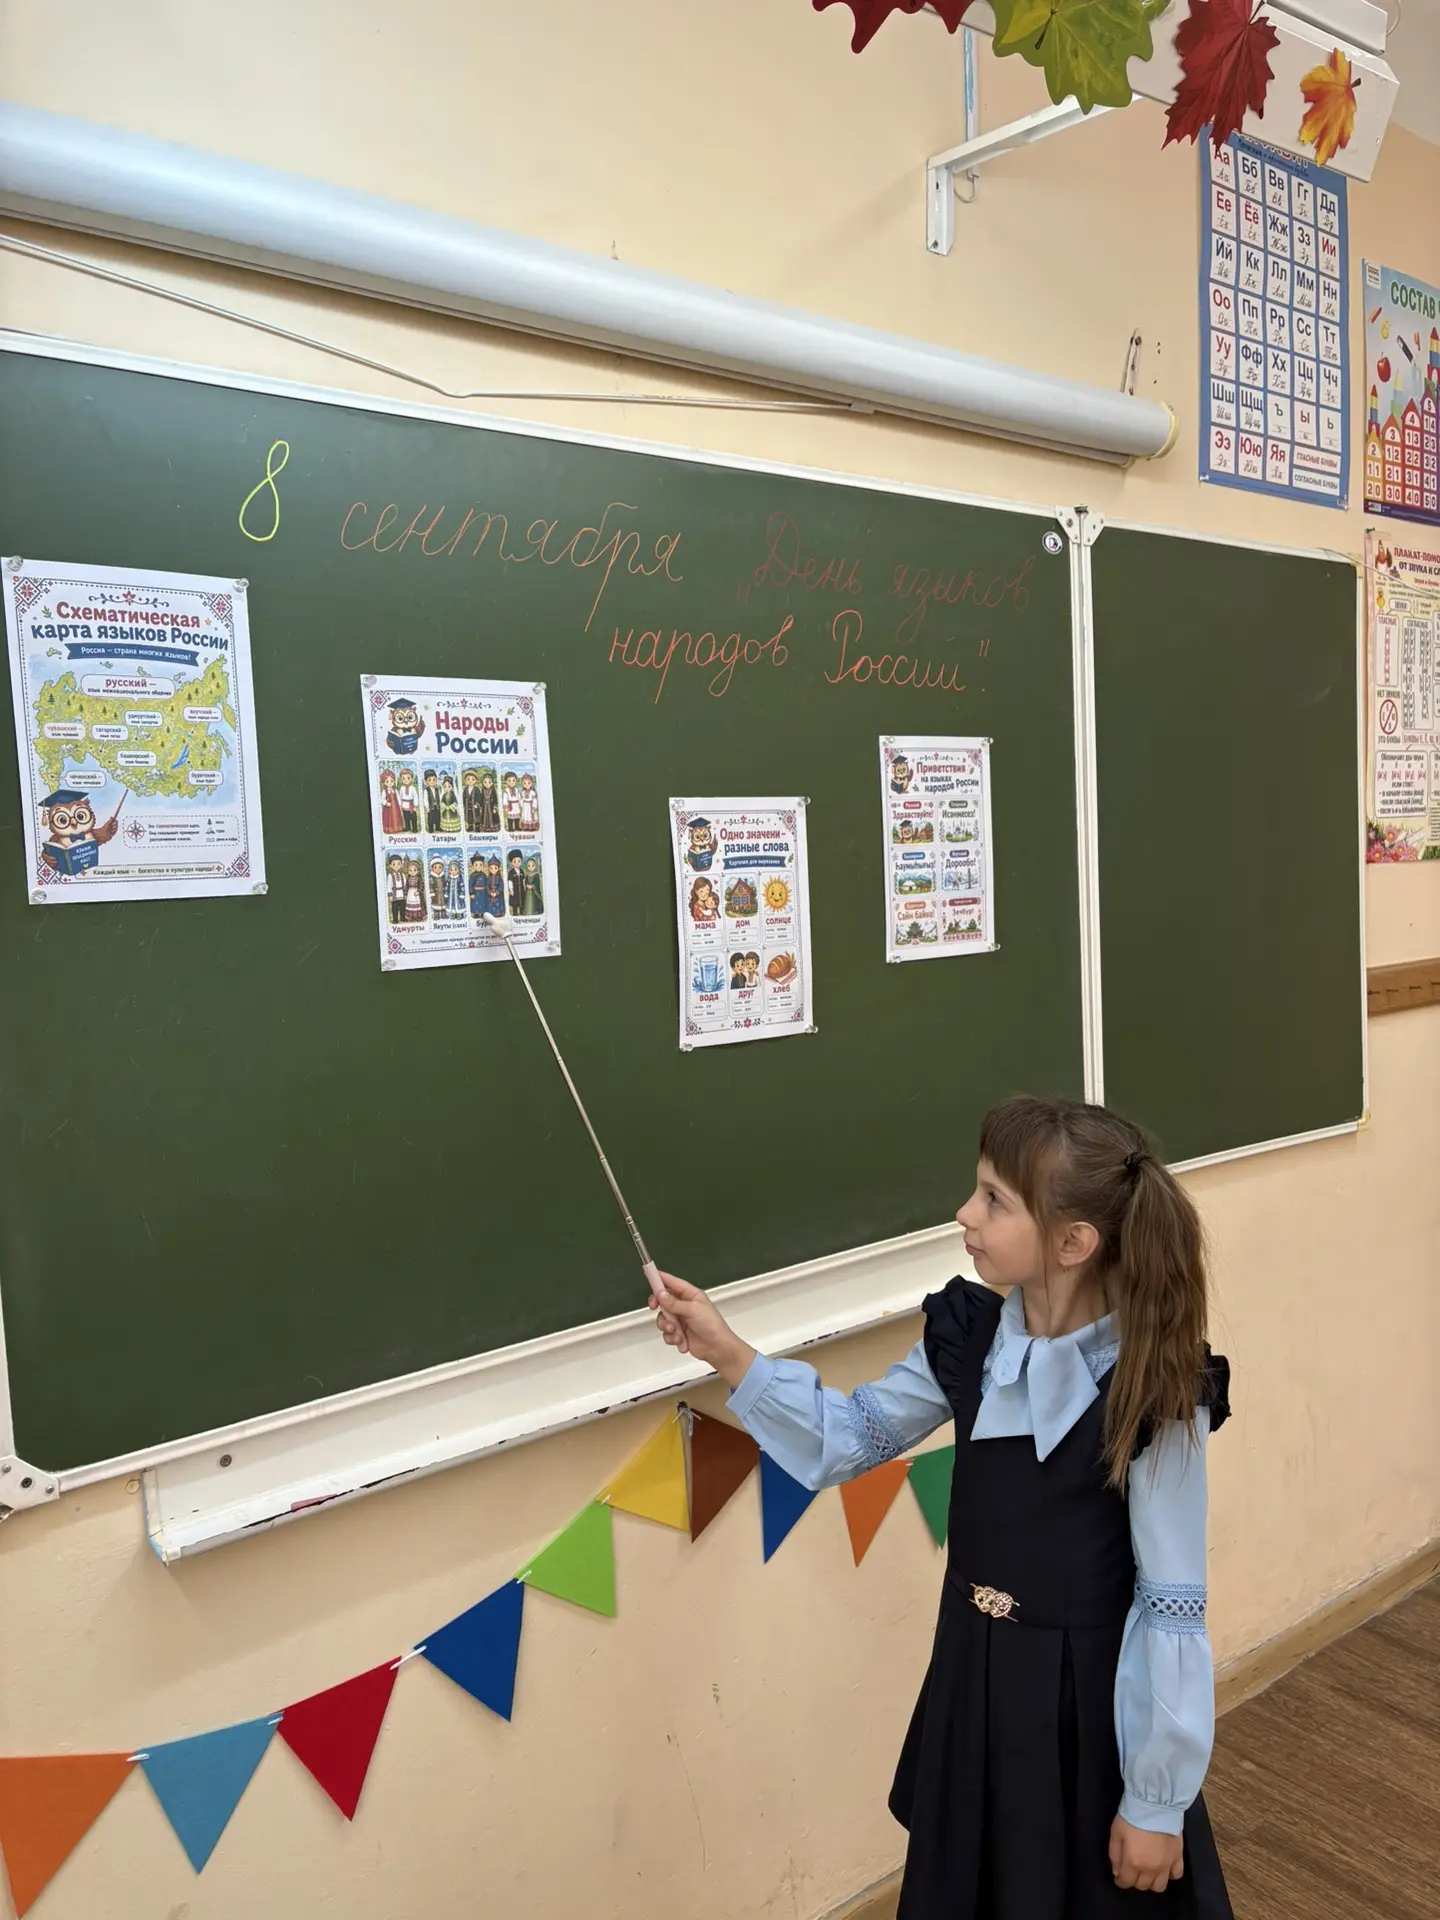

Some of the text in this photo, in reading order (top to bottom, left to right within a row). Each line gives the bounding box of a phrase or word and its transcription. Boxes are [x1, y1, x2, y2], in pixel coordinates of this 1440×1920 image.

[1242, 157, 1258, 178] Бб
[1268, 169, 1284, 190] Вв
[1297, 182, 1308, 200] Гг
[1320, 194, 1336, 216] Дд
[1216, 190, 1336, 257] Ее Ёё Жж Зз Ии
[1216, 237, 1337, 300] Йй Кк Лл Мм Нн
[1391, 281, 1436, 319] СОСТАВ
[1213, 289, 1336, 344] Оо Пп Рр Сс Тт
[1216, 335, 1338, 387] Уу Фф Хх Цц Чч
[1212, 383, 1234, 404] Шш
[1241, 390, 1263, 414] Щщ
[1427, 400, 1432, 410] 5
[1410, 414, 1415, 426] 4
[1425, 417, 1435, 429] 1 4
[1390, 429, 1395, 440] 3
[1407, 434, 1419, 446] 1 3
[1215, 431, 1285, 463] Ээ Юю Яя
[1424, 436, 1435, 449] 2 3
[1371, 444, 1376, 456] 2
[1387, 449, 1400, 460] 1 2
[1296, 452, 1337, 468] ГЛАСНЫЕ БУКВЫ
[1407, 453, 1419, 464] 2 2
[1425, 456, 1436, 468] 3 2
[1368, 464, 1379, 476] 1 1
[1387, 468, 1399, 480] 2 1
[1294, 472, 1337, 489] СОГЛАСНЫЕ БУКВЫ
[1407, 471, 1418, 484] 3 1
[1424, 476, 1435, 488] 4 1
[1368, 484, 1380, 496] 2 0
[1387, 488, 1400, 500] 3 0
[1406, 492, 1419, 504] 4 0
[1425, 495, 1436, 508] 5 0
[239, 440, 684, 633] 8 сентября
[887, 555, 1036, 645] языков
[56, 602, 200, 628] Схематическая
[30, 624, 229, 651] карта языков России
[165, 652, 191, 660] языков!
[609, 614, 795, 705] народов
[105, 679, 147, 688] русский
[435, 711, 509, 735] Народы
[435, 732, 518, 754] России
[917, 762, 965, 775] Приветствия
[925, 779, 979, 794] народов России
[892, 811, 933, 820] Здравствуйте!
[720, 828, 744, 841] Одно
[724, 842, 789, 856] разные слова
[392, 925, 424, 933] Удмурты
[735, 920, 750, 928] дом
[699, 985, 790, 1002] вода друг хлеб
